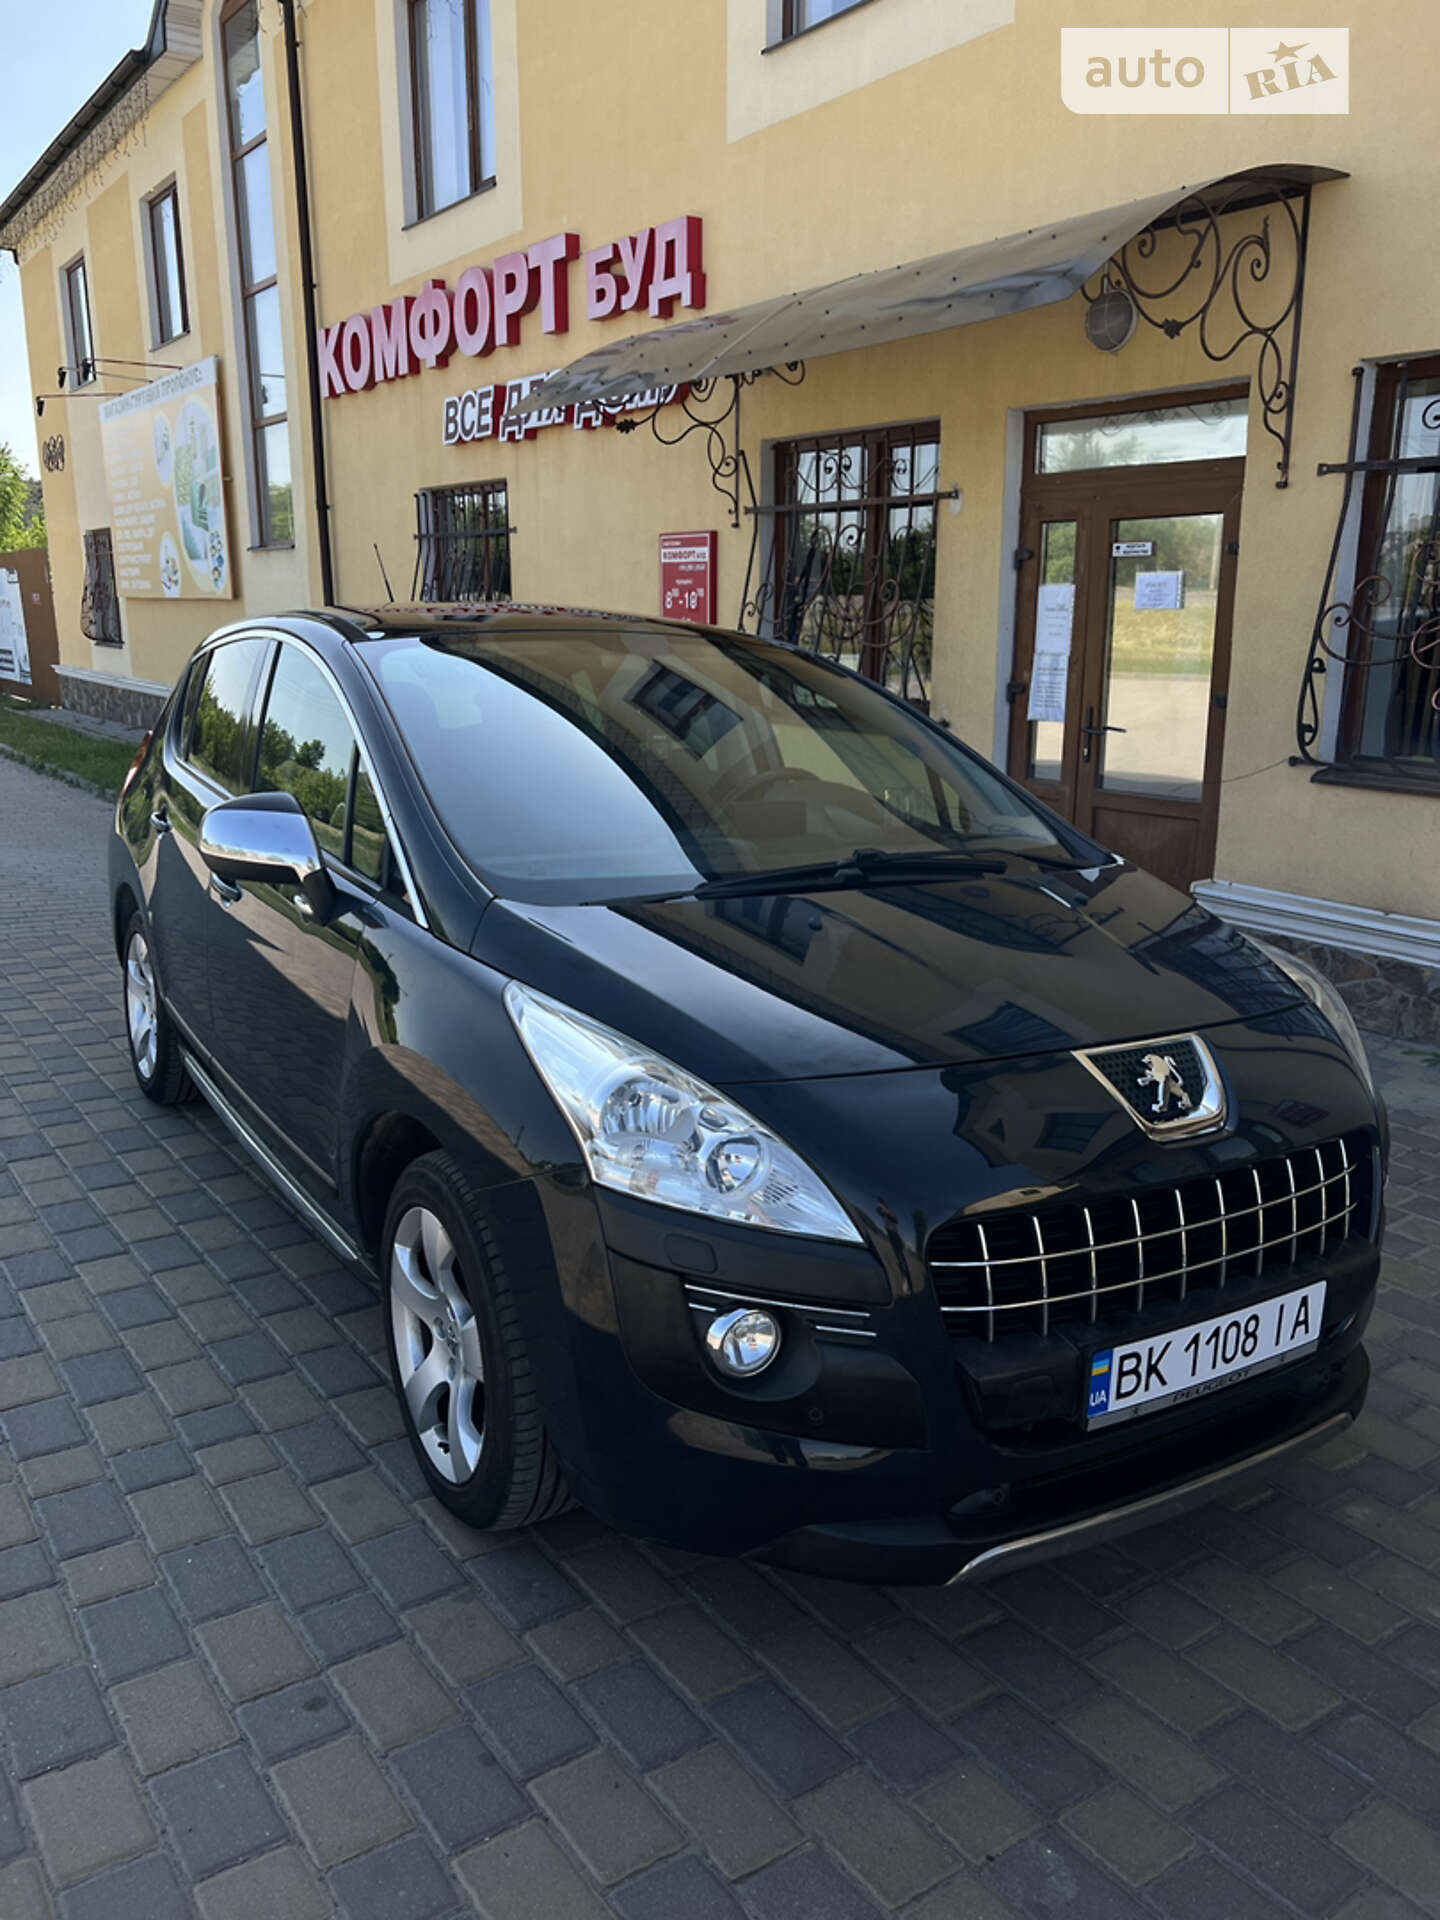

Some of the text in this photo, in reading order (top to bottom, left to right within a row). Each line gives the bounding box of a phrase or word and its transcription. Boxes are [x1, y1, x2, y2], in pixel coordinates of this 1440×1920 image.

[317, 214, 704, 399] КОМФОРТ БУД
[443, 384, 495, 445] ВСЕ
[1116, 1295, 1310, 1400] BK 1108 IA
[1090, 1389, 1107, 1407] UA
